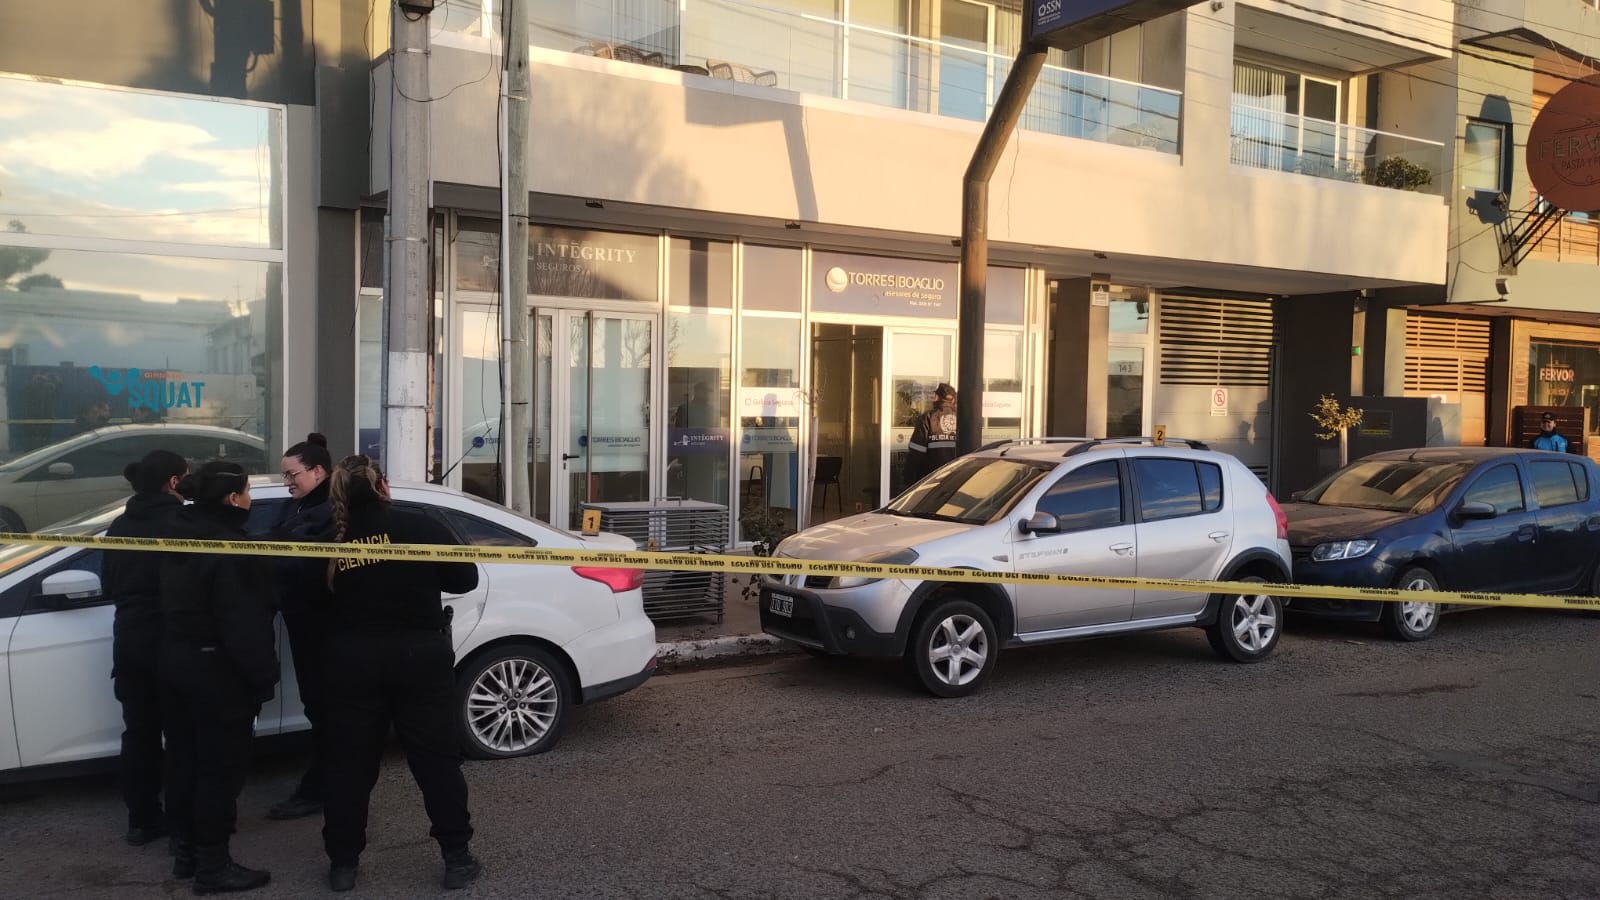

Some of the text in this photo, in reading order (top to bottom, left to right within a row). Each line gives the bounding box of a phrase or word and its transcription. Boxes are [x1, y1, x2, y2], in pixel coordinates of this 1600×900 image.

[1538, 134, 1600, 160] FERV
[536, 262, 583, 273] SEGUROS
[848, 272, 896, 287] TORRES
[1119, 364, 1132, 373] 143
[1540, 368, 1575, 382] FERVOR
[128, 381, 205, 414] SQUAT
